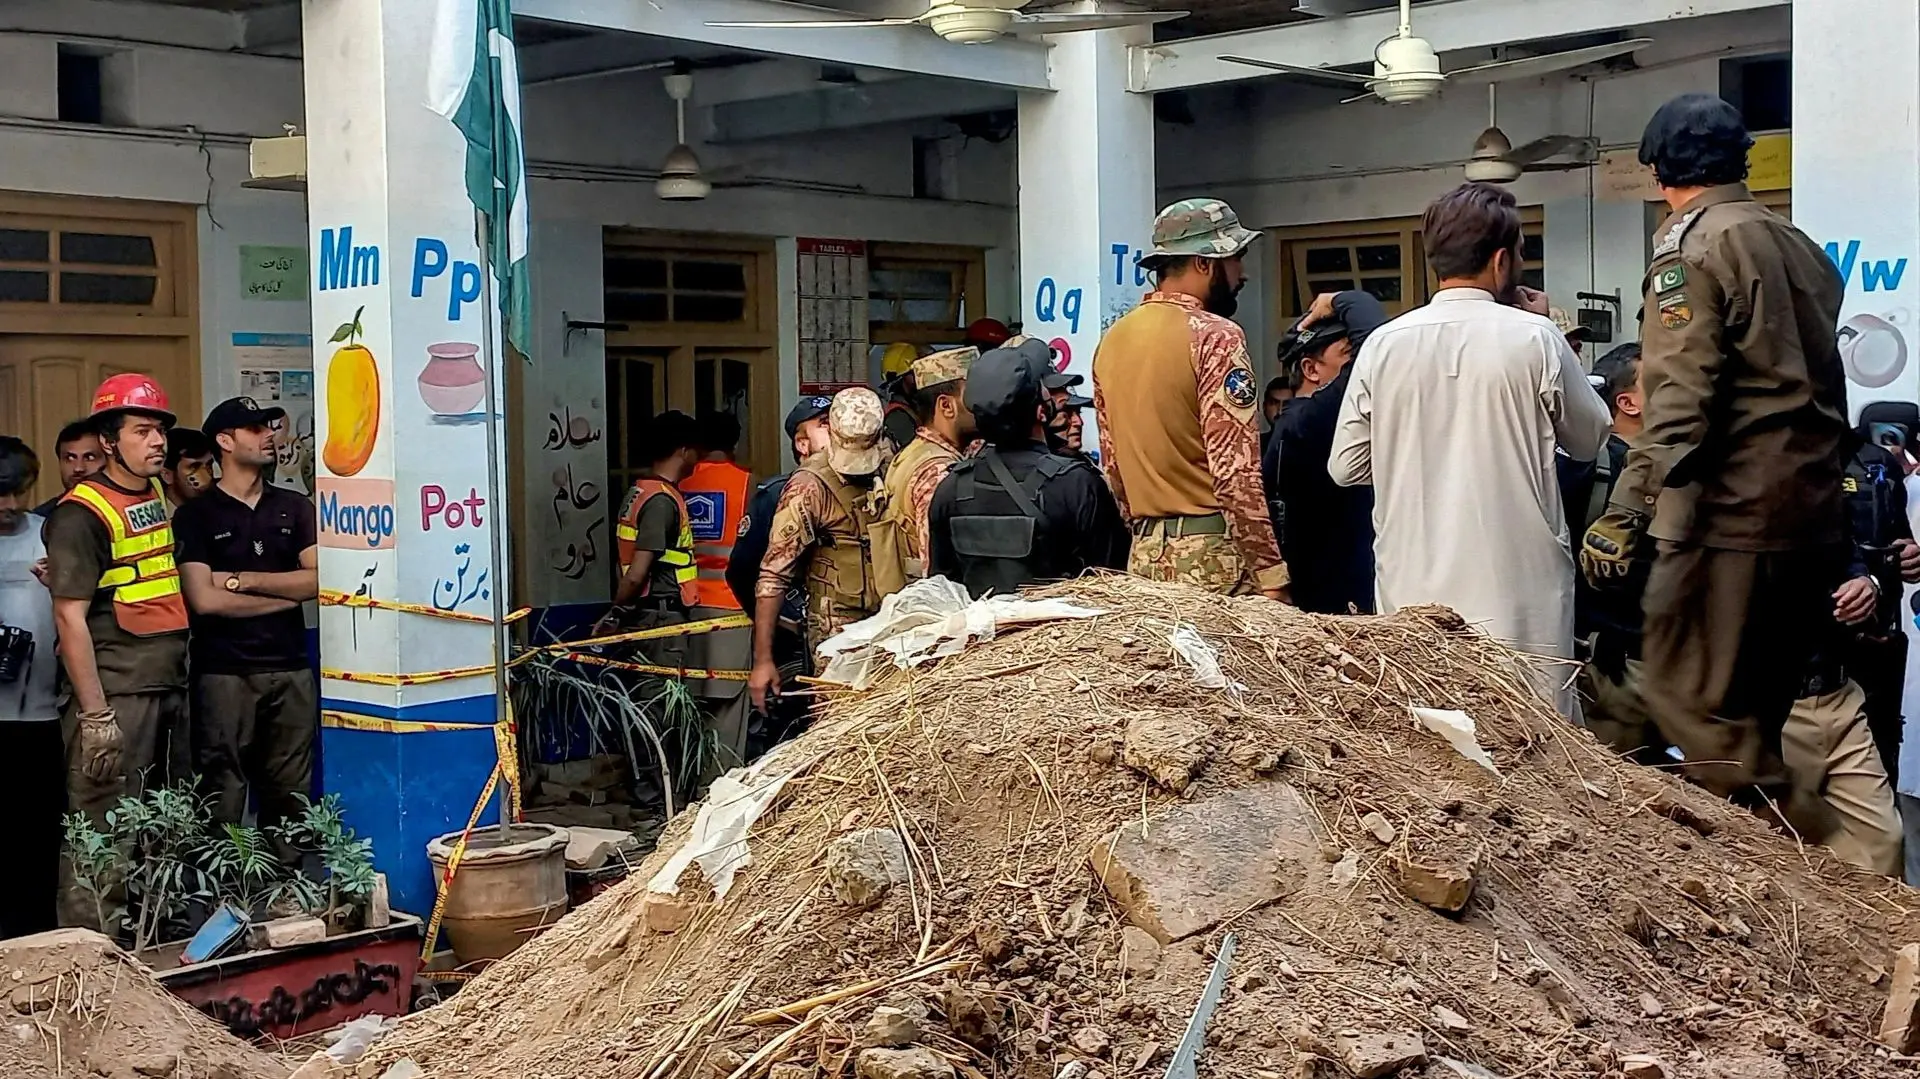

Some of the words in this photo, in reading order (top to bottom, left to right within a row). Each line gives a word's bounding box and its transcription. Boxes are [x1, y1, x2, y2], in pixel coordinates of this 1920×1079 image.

[319, 226, 380, 291] Mm
[411, 237, 482, 321] Pp
[1111, 243, 1146, 287] Tt
[1035, 277, 1083, 334] Qq
[542, 405, 601, 450] سلام
[320, 491, 394, 547] Mango
[420, 485, 485, 531] Pot
[553, 462, 601, 532] عام
[433, 543, 488, 611] برتن
[552, 516, 605, 579] کرو
